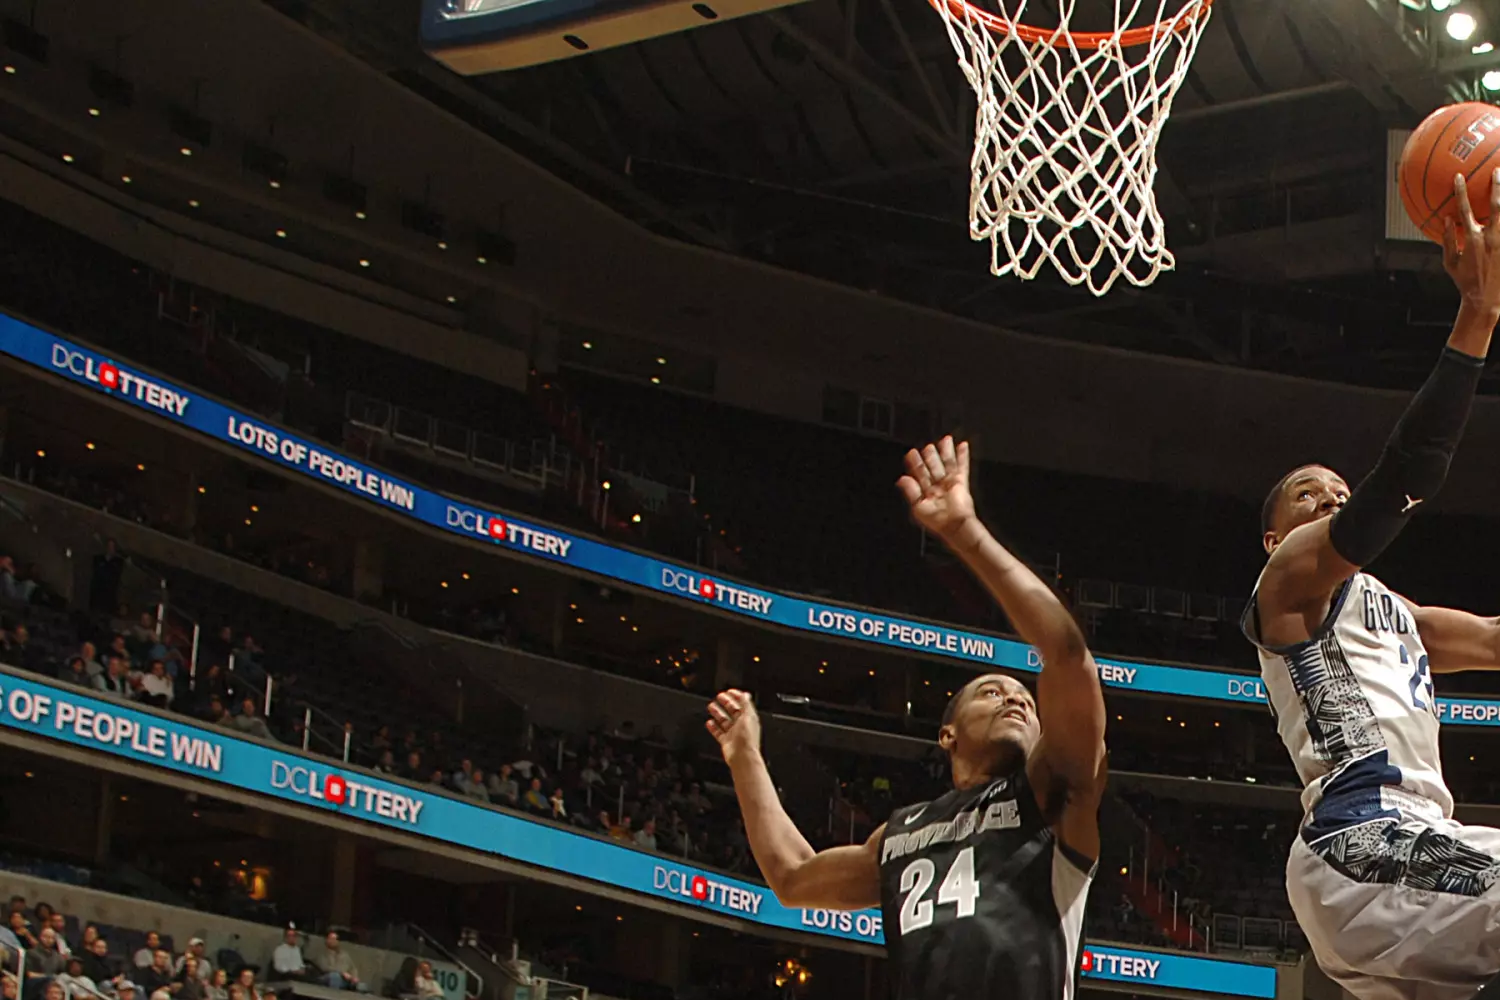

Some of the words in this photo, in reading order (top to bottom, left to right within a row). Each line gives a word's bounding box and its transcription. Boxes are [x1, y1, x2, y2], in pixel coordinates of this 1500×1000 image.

[228, 416, 279, 455] LOTS
[280, 438, 308, 464] OF
[309, 450, 379, 496] PEOPLE
[380, 479, 414, 511] WIN
[808, 608, 856, 633] LOTS
[860, 617, 885, 637] OF
[888, 625, 957, 653] PEOPLE
[961, 637, 994, 659] WIN
[8, 689, 51, 721] OF
[55, 700, 166, 757] PEOPLE
[170, 732, 222, 771] WIN
[801, 908, 852, 932] LOTS
[856, 914, 882, 937] OF
[900, 846, 980, 935] 24
